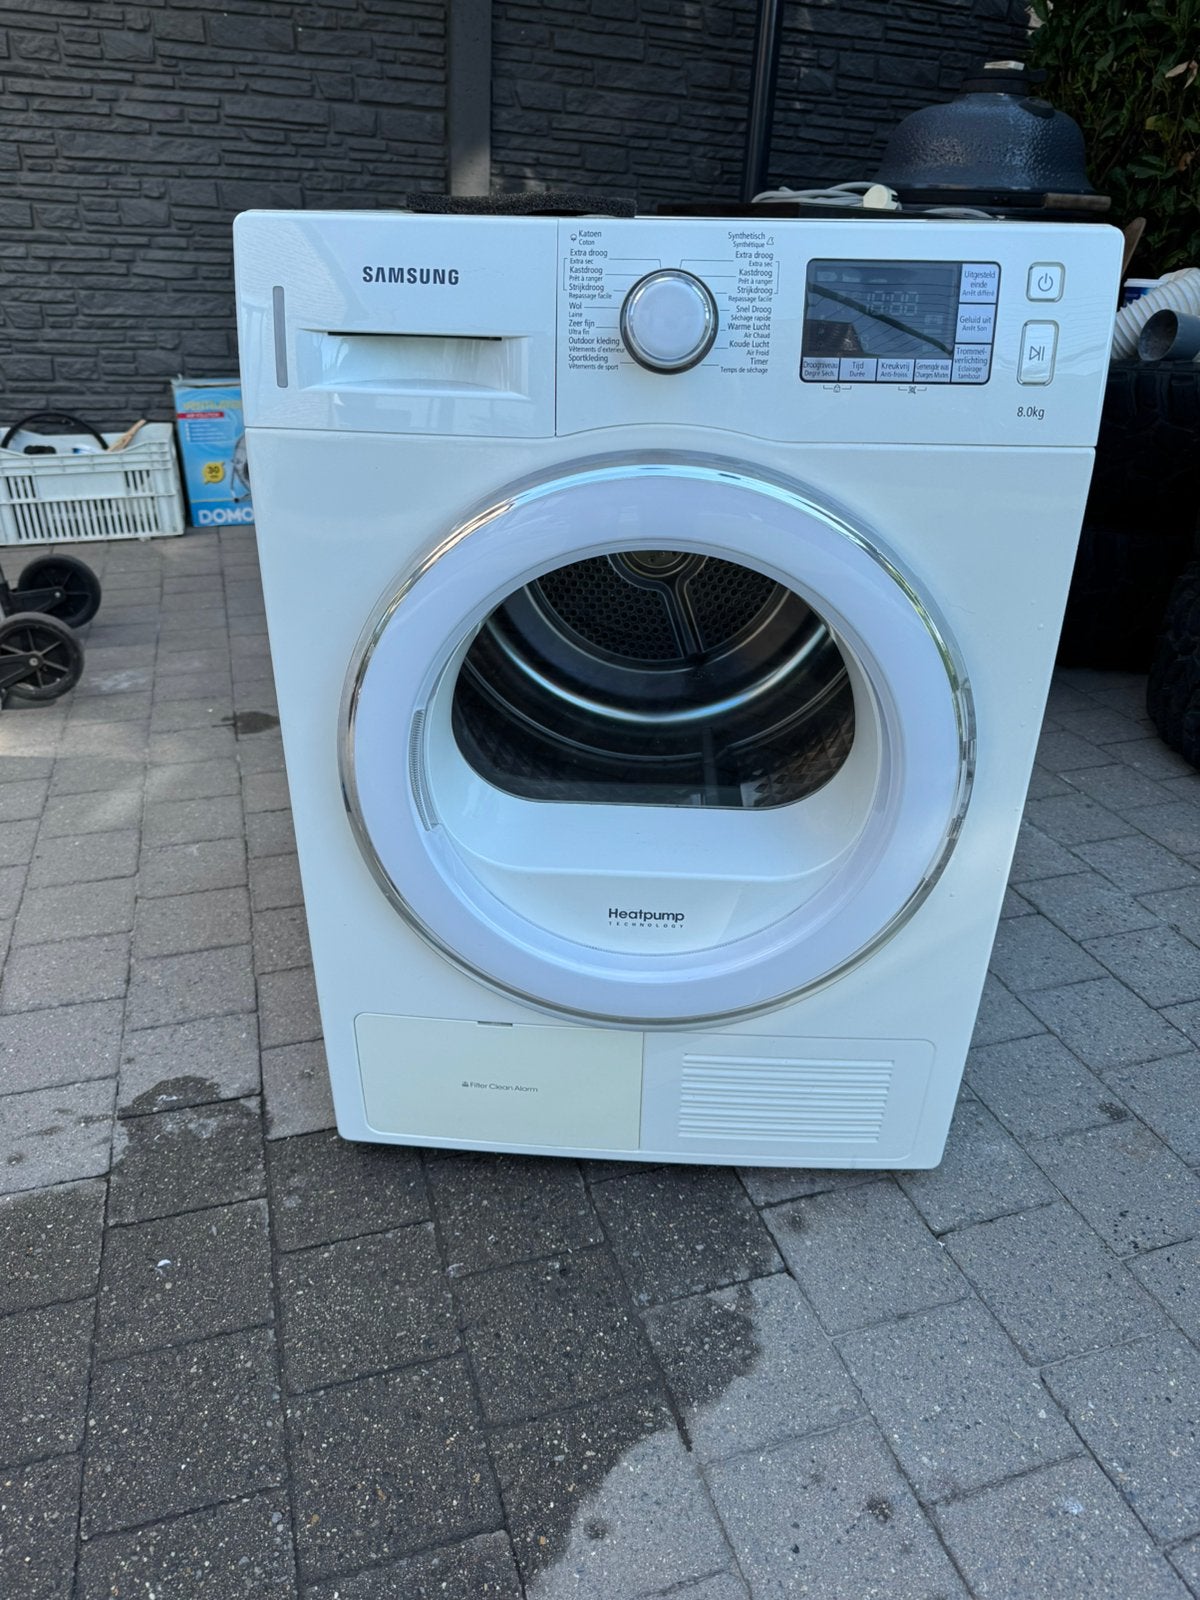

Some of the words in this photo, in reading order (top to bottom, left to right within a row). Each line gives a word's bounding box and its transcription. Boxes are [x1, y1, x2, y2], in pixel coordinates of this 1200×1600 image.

[578, 230, 602, 238] Katoen
[728, 231, 766, 241] Synthetisch
[569, 249, 587, 257] Extra
[588, 249, 608, 259] droog
[735, 250, 752, 259] Extra
[753, 251, 774, 261] droog
[569, 257, 584, 265] Extra
[362, 266, 460, 285] SAMSUNG
[569, 266, 603, 276] Kastdroog
[738, 268, 773, 279] Kastdroog
[964, 270, 996, 280] Uitgesteld
[585, 276, 603, 284] ranger
[970, 280, 988, 289] einde
[568, 282, 605, 293] Strijkdroog
[736, 285, 774, 296] Strijkdroog
[568, 301, 583, 310] Wol
[735, 304, 751, 313] Snel
[751, 305, 773, 315] Droog
[568, 319, 583, 327] Zeer
[584, 319, 595, 330] fijn
[959, 316, 981, 324] Geluid
[982, 315, 992, 324] uit
[727, 322, 751, 331] Warme
[752, 322, 771, 331] Lucht
[568, 336, 595, 345] Outdoor
[596, 337, 620, 347] kleding
[728, 340, 751, 349] Koude
[751, 340, 770, 349] Lucht
[568, 354, 609, 364] Sportkleding
[750, 357, 769, 366] Timer
[852, 361, 865, 371] Tijd
[881, 361, 911, 372] Kreukvrij
[1016, 406, 1045, 421] 8.0kg
[198, 507, 254, 525] DOMO
[608, 907, 685, 923] Heatpump
[608, 921, 684, 929] TECHNOLOGY
[470, 1081, 488, 1089] Filter
[488, 1082, 513, 1091] Clean
[514, 1085, 539, 1093] Alarm
